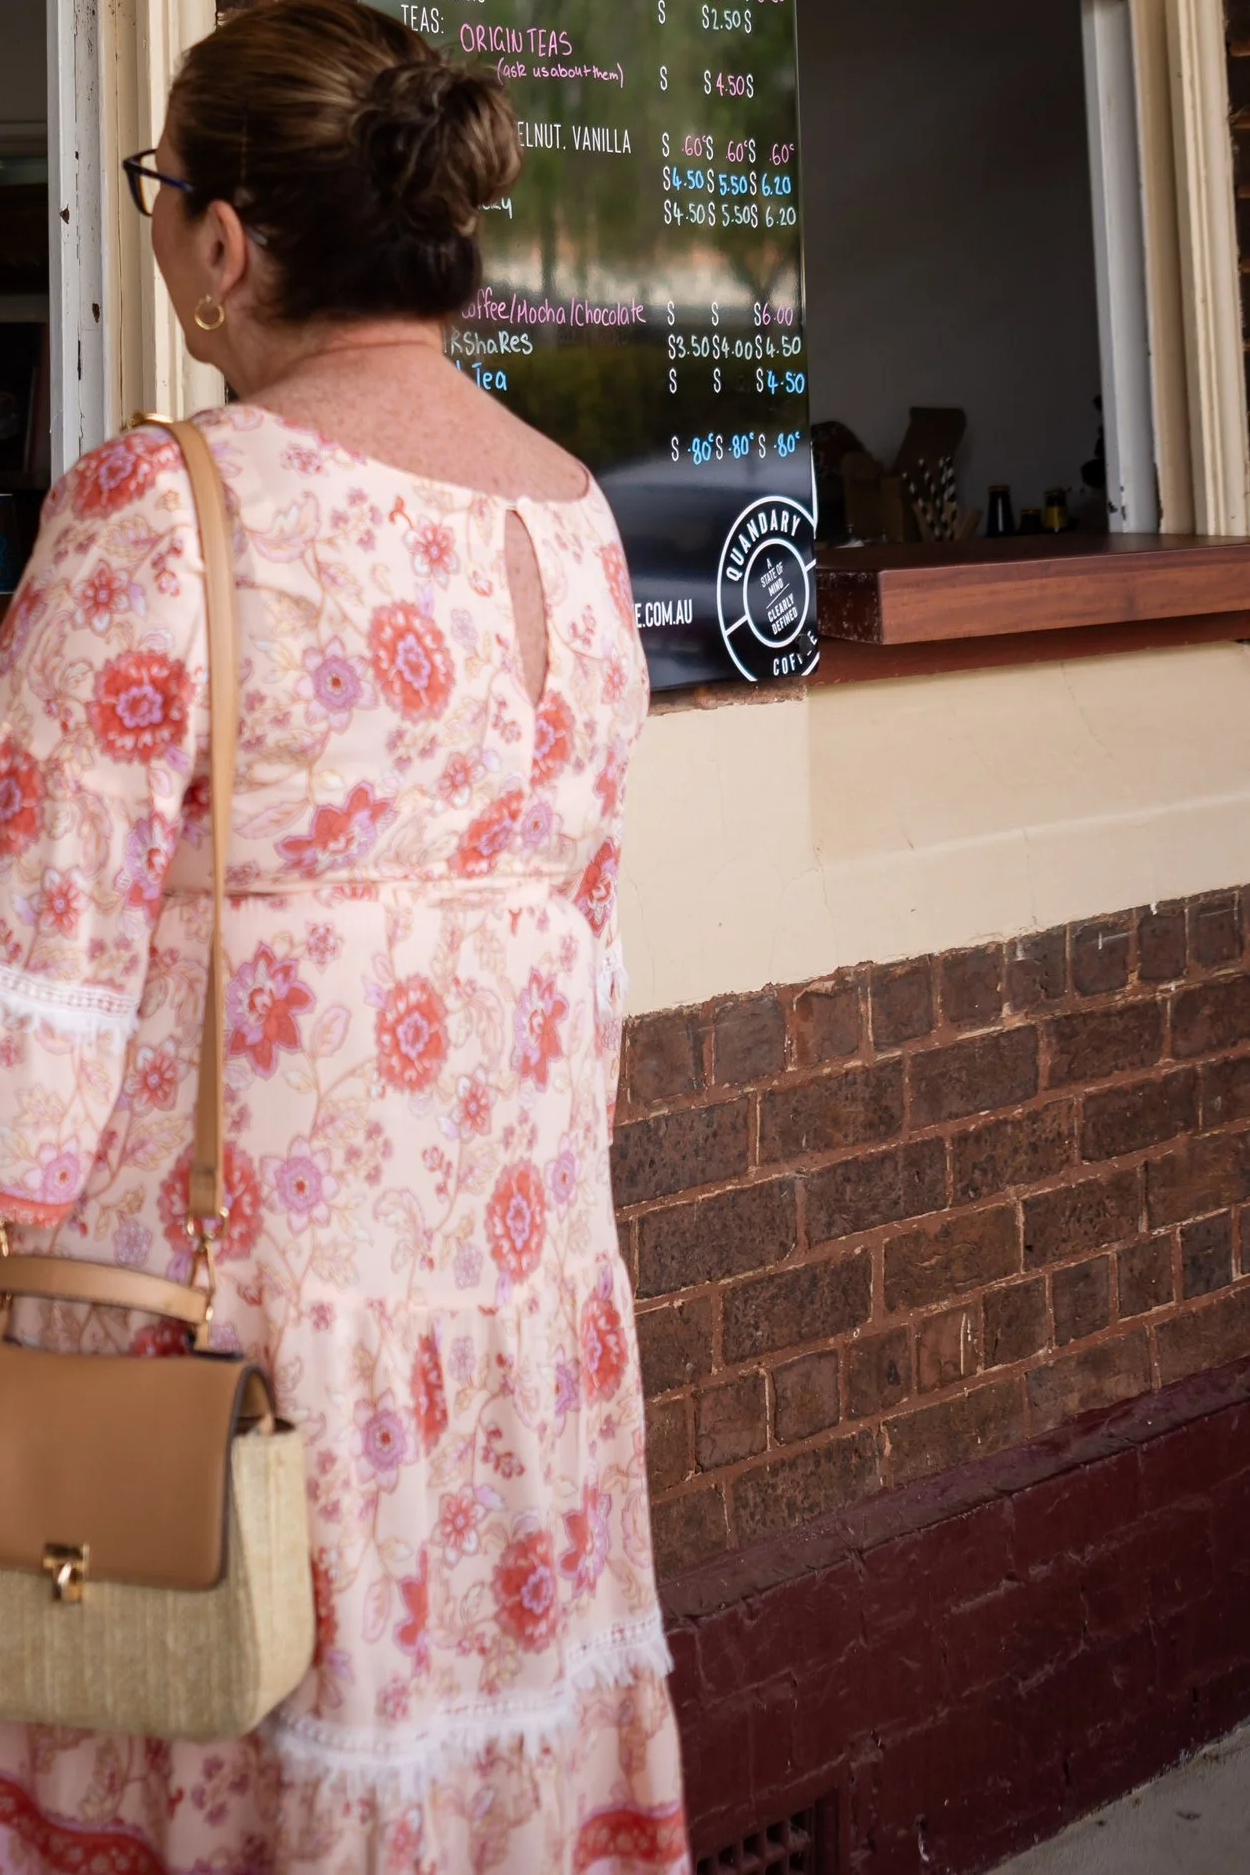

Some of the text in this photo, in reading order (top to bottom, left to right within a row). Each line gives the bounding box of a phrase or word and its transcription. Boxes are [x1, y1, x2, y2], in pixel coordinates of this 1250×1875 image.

[400, 4, 444, 34] TEAS:
[527, 28, 573, 57] TEAS
[517, 122, 631, 154] ELNUT. VANILLA
[471, 362, 507, 392] Tea
[726, 509, 800, 582] QUANDARY
[760, 561, 783, 588] STATE OF
[768, 578, 784, 597] MIND
[767, 592, 795, 623] CLEARLY
[771, 606, 798, 636] DEFINED
